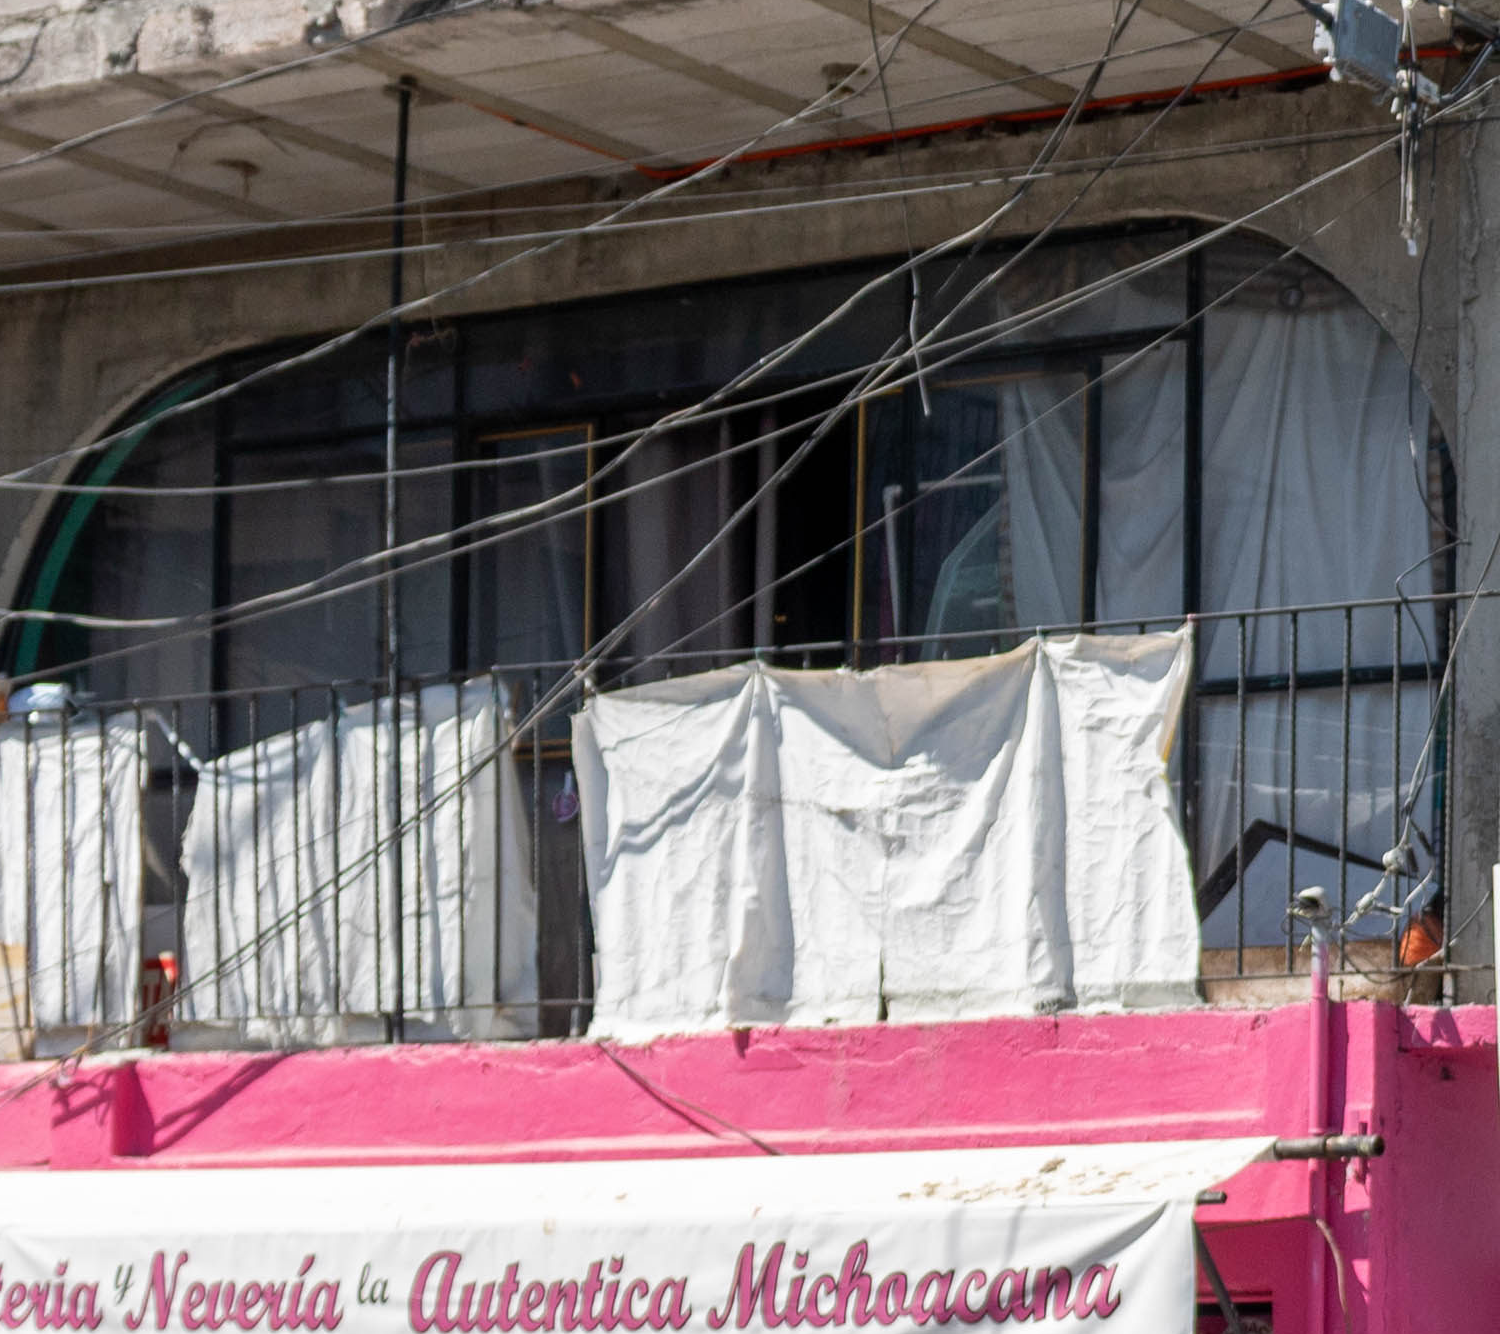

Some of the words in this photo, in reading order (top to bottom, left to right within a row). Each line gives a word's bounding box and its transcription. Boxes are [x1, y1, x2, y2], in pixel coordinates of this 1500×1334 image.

[113, 1264, 134, 1306] y
[124, 1250, 345, 1332] Nevería
[357, 1263, 390, 1306] la
[408, 1251, 693, 1333] Autentica
[708, 1239, 1123, 1331] Michoacana
